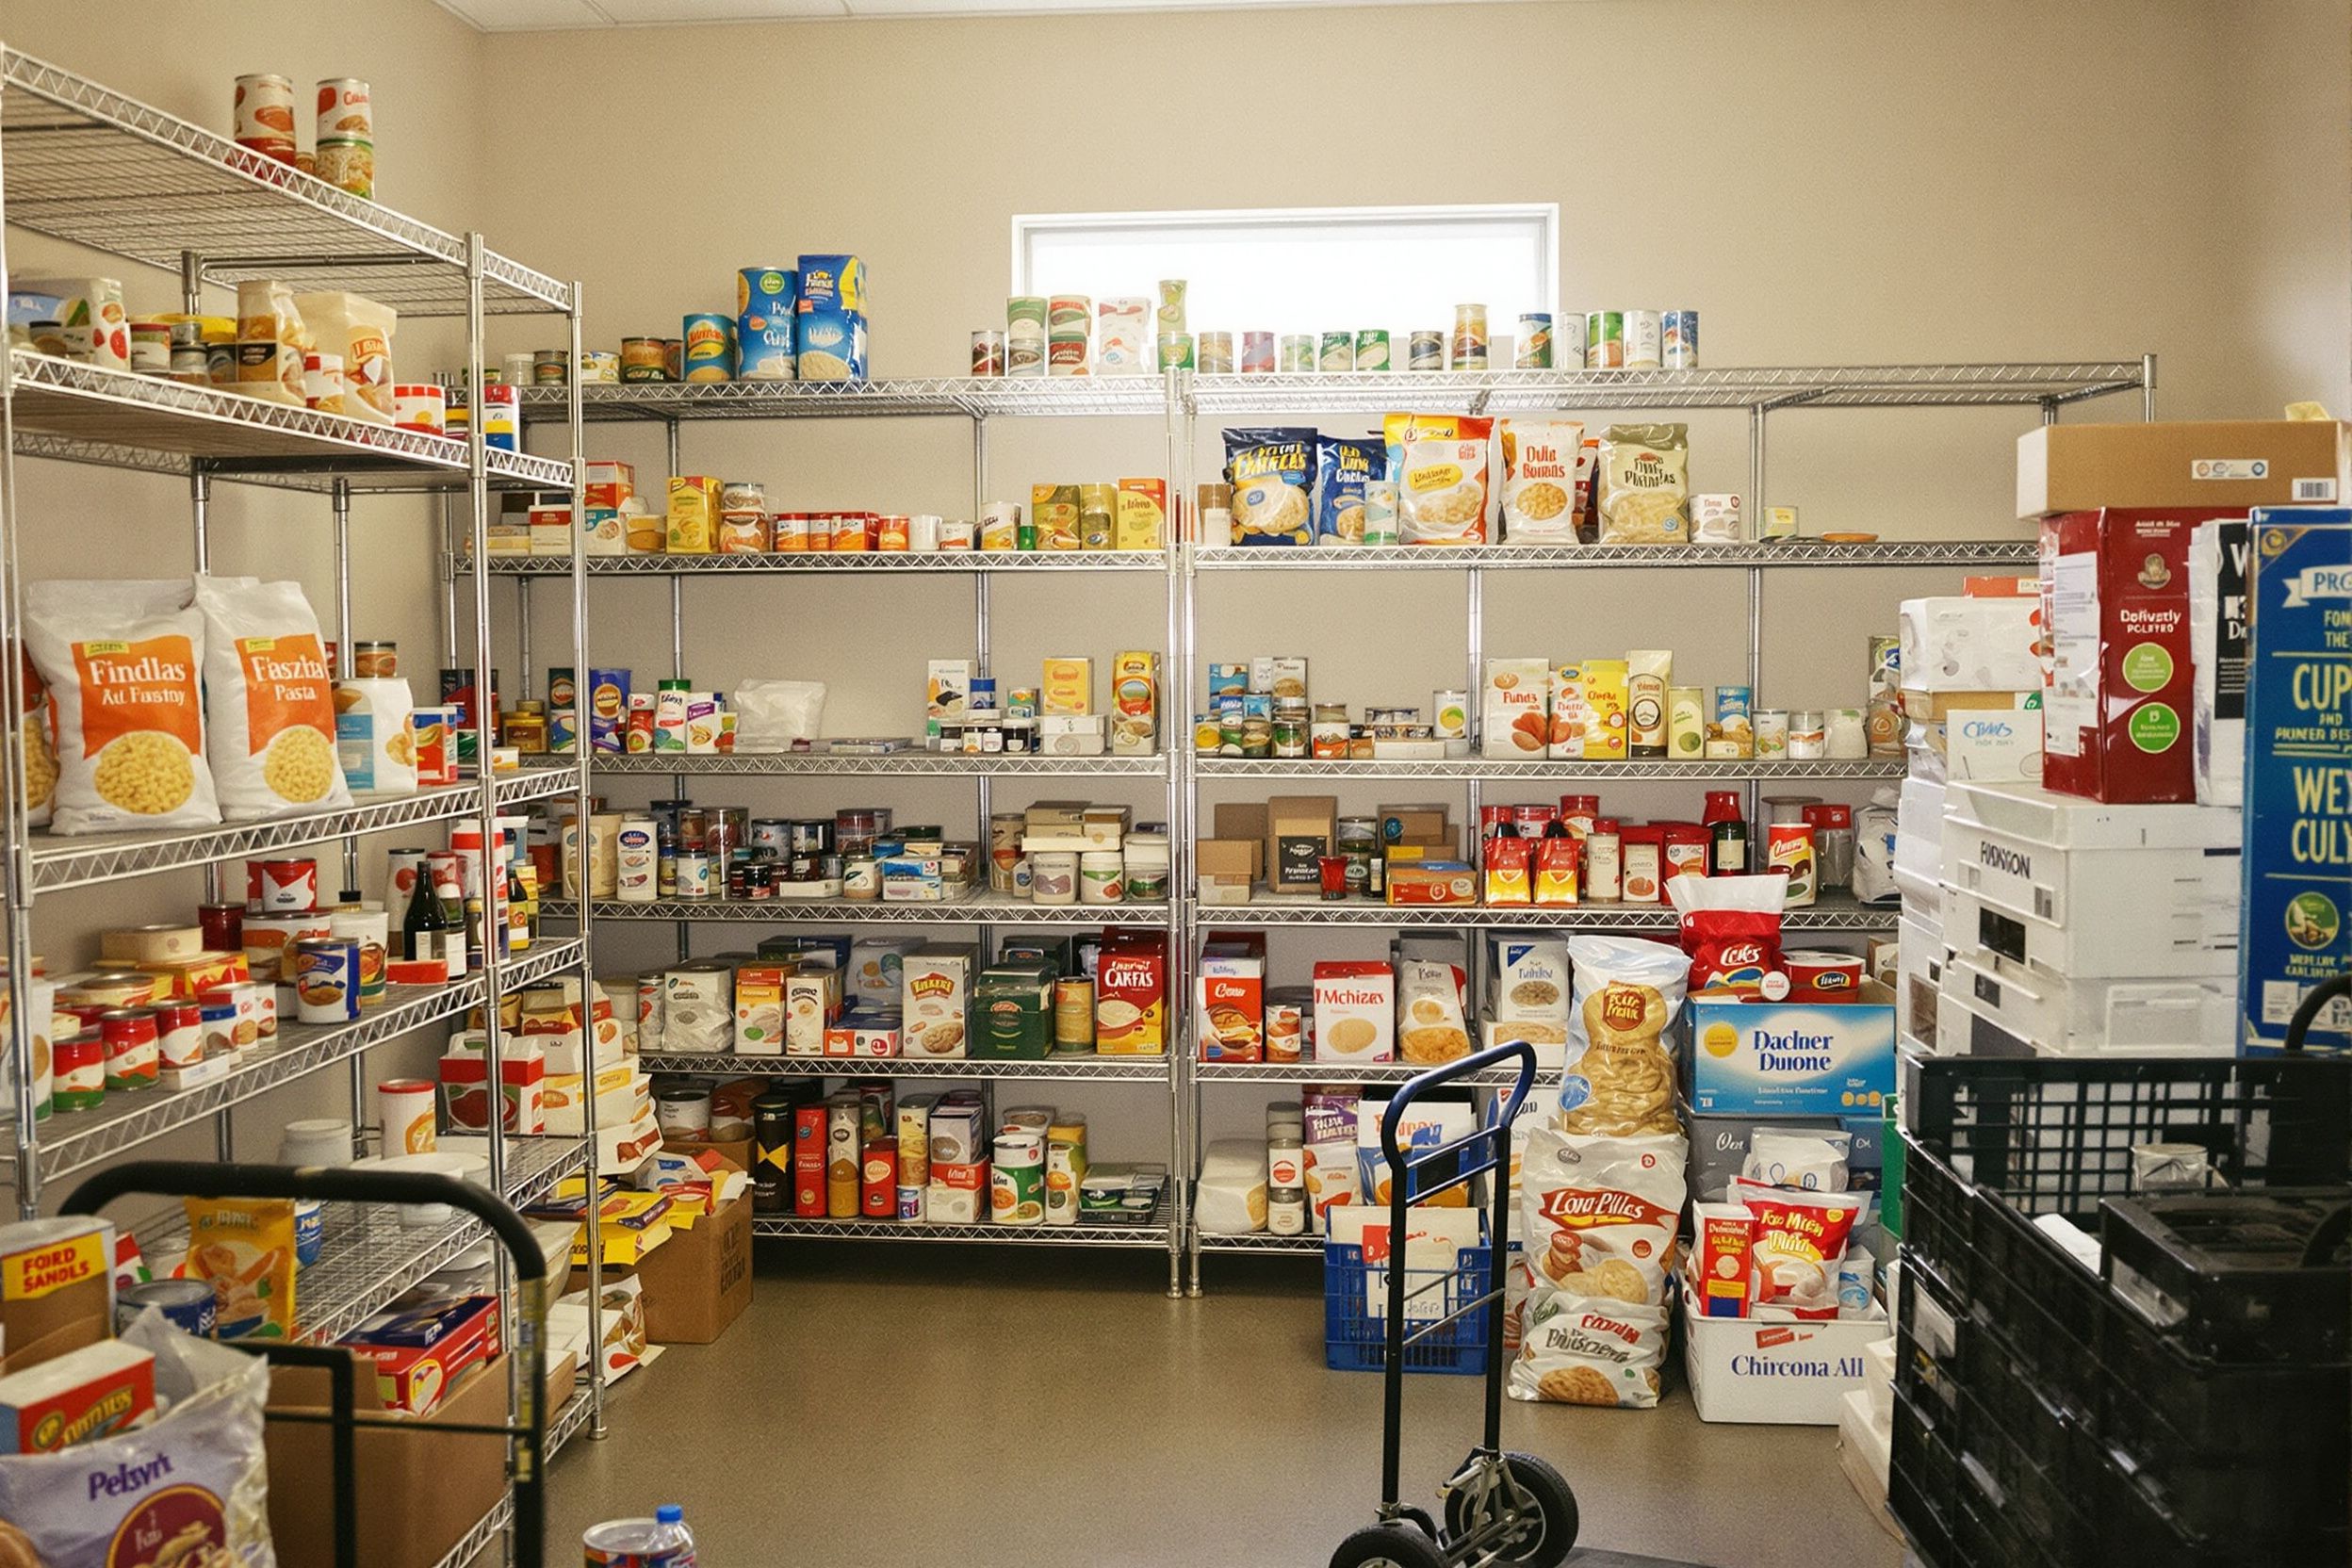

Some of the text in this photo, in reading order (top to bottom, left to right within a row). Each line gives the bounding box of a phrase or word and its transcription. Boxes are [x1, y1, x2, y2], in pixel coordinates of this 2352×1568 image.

[274, 684, 317, 702] Pasta
[1731, 1354, 1864, 1377] Chircona All
